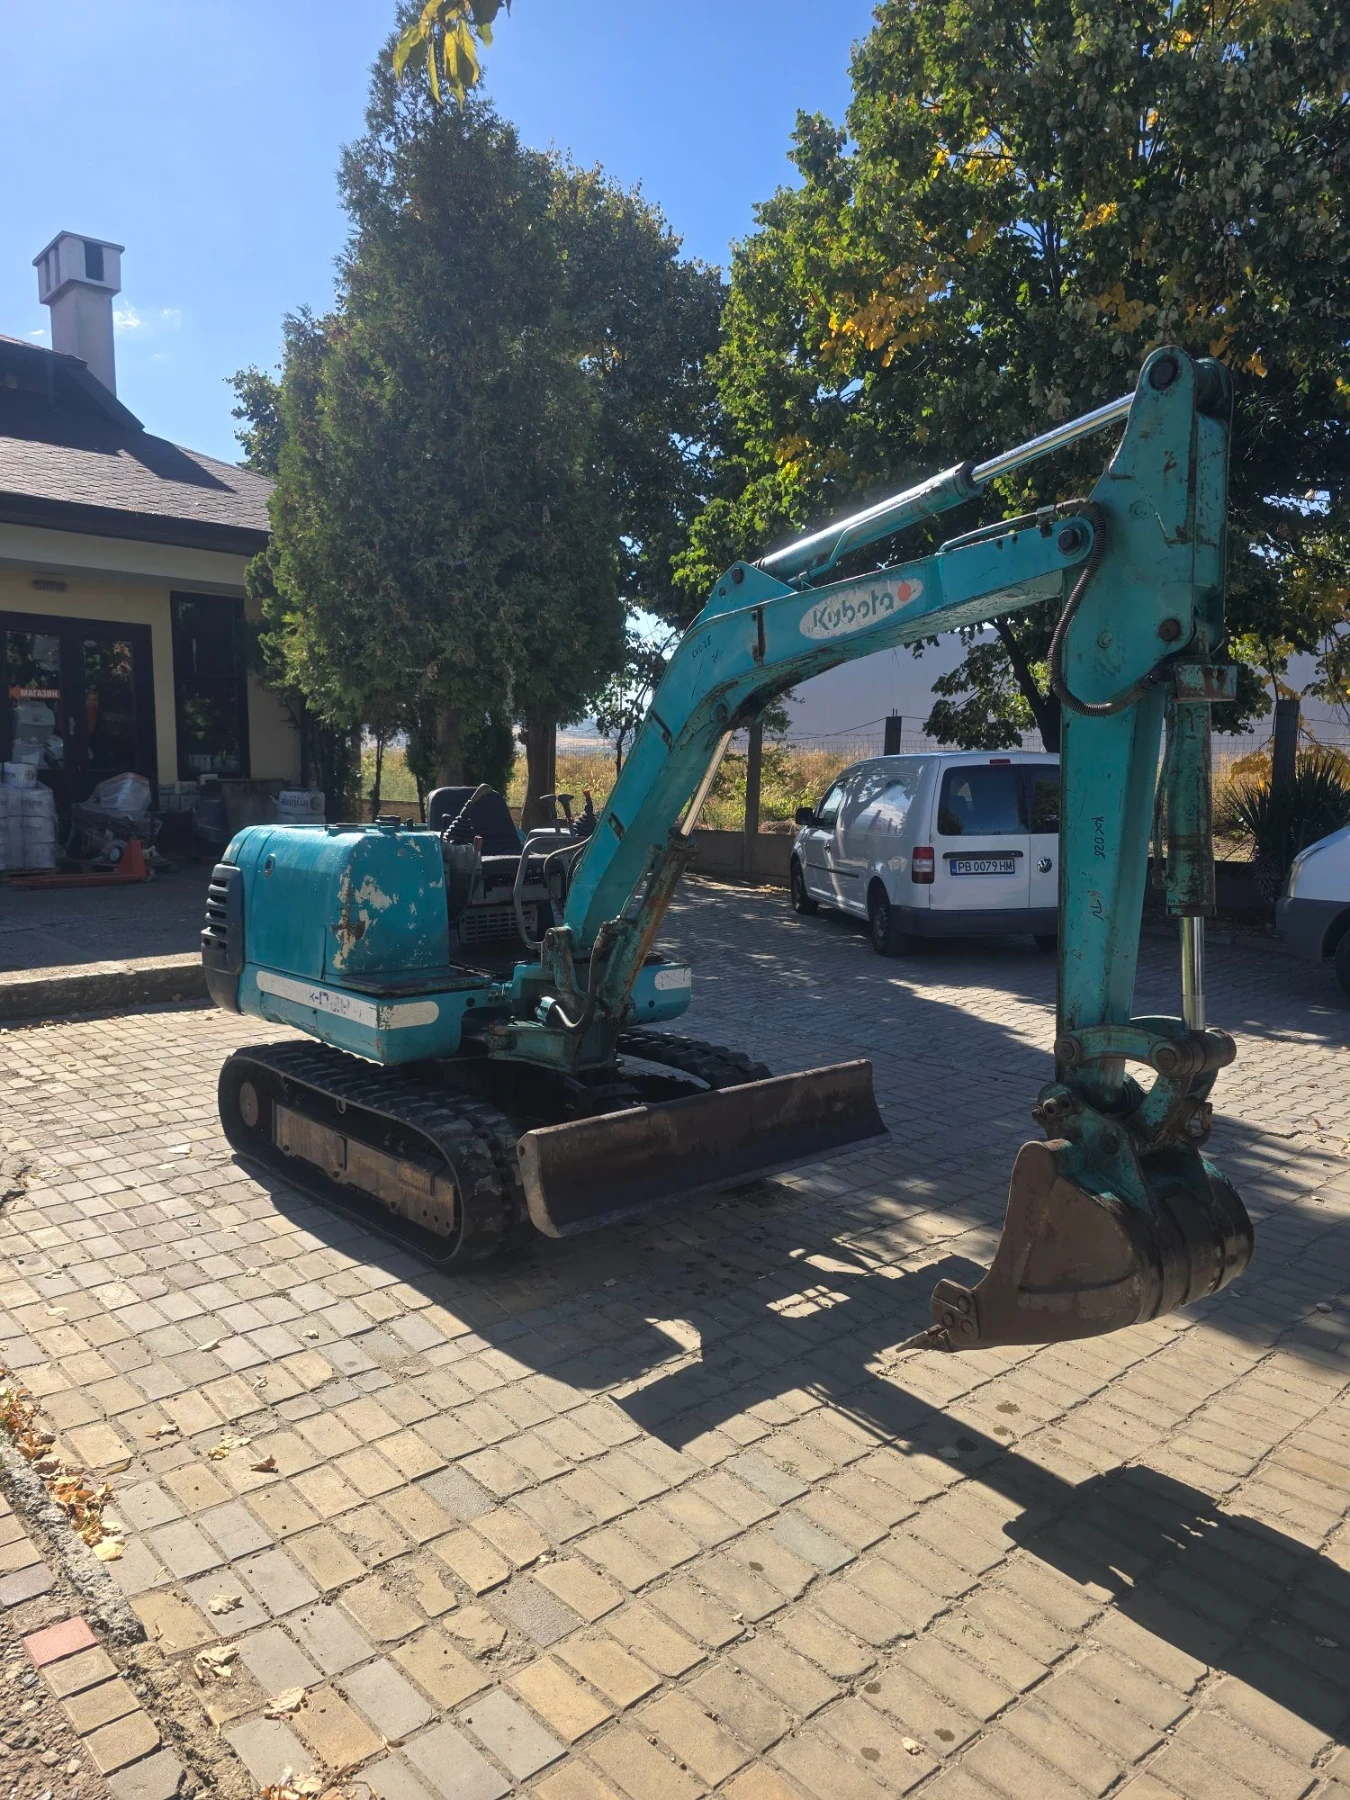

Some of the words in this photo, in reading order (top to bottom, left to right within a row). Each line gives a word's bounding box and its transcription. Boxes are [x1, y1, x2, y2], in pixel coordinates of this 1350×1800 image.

[812, 590, 895, 631] Kubota
[20, 688, 58, 698] МАГАЗИН
[958, 861, 972, 872] PB
[973, 861, 998, 872] 0079
[999, 860, 1014, 871] HM
